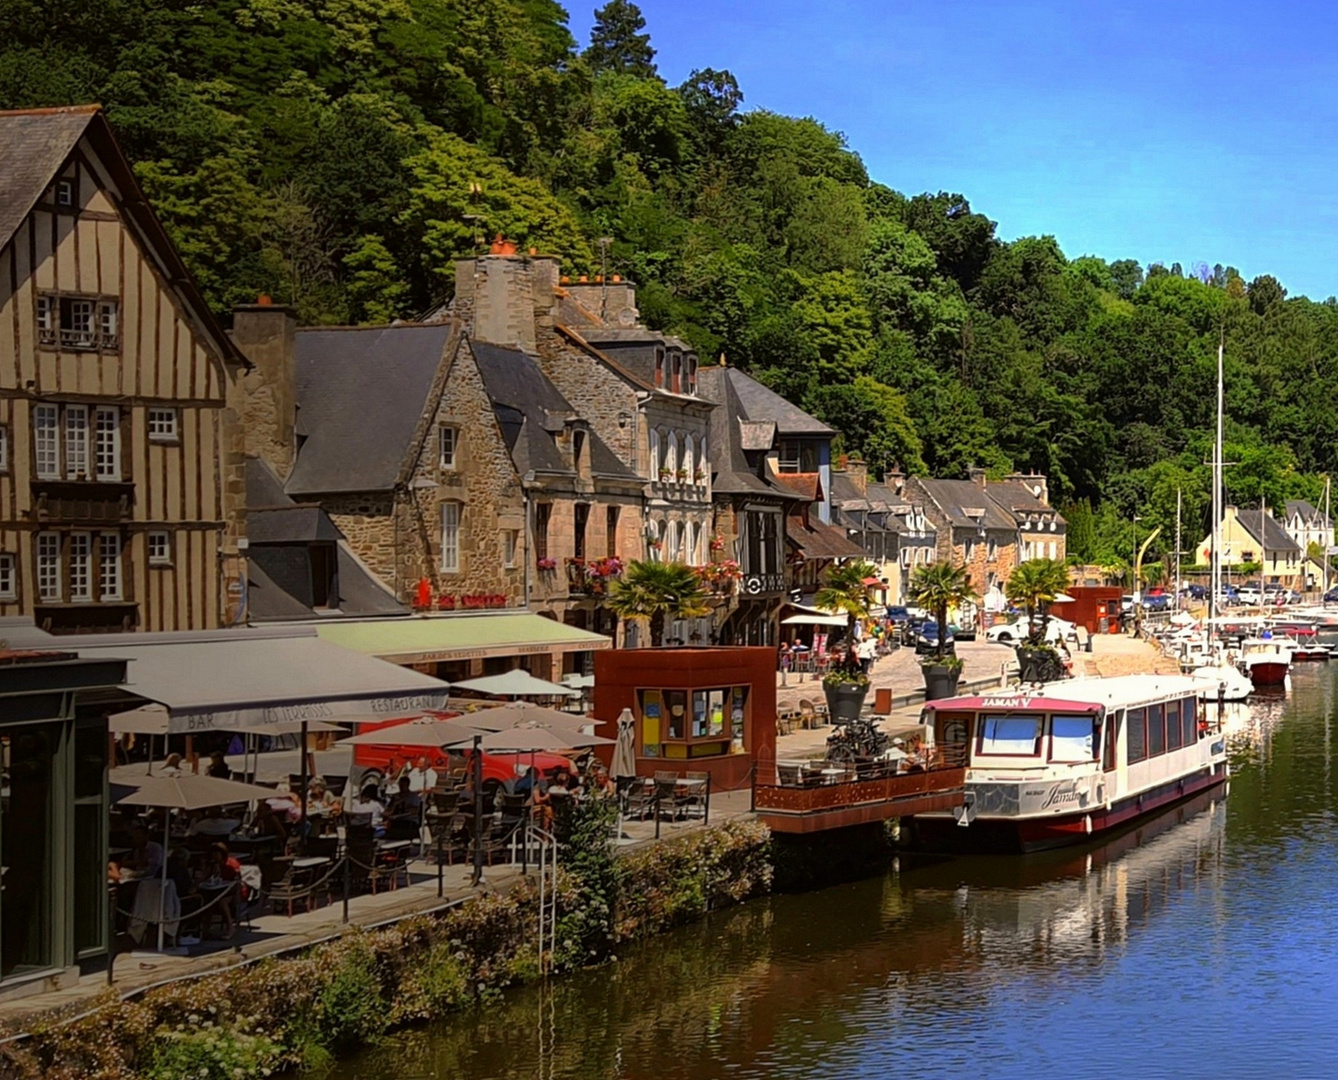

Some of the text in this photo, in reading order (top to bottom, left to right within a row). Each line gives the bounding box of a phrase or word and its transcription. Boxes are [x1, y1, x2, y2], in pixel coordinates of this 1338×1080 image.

[982, 698, 1032, 708] JAMAN V
[187, 713, 215, 729] BAR
[262, 709, 279, 724] LES
